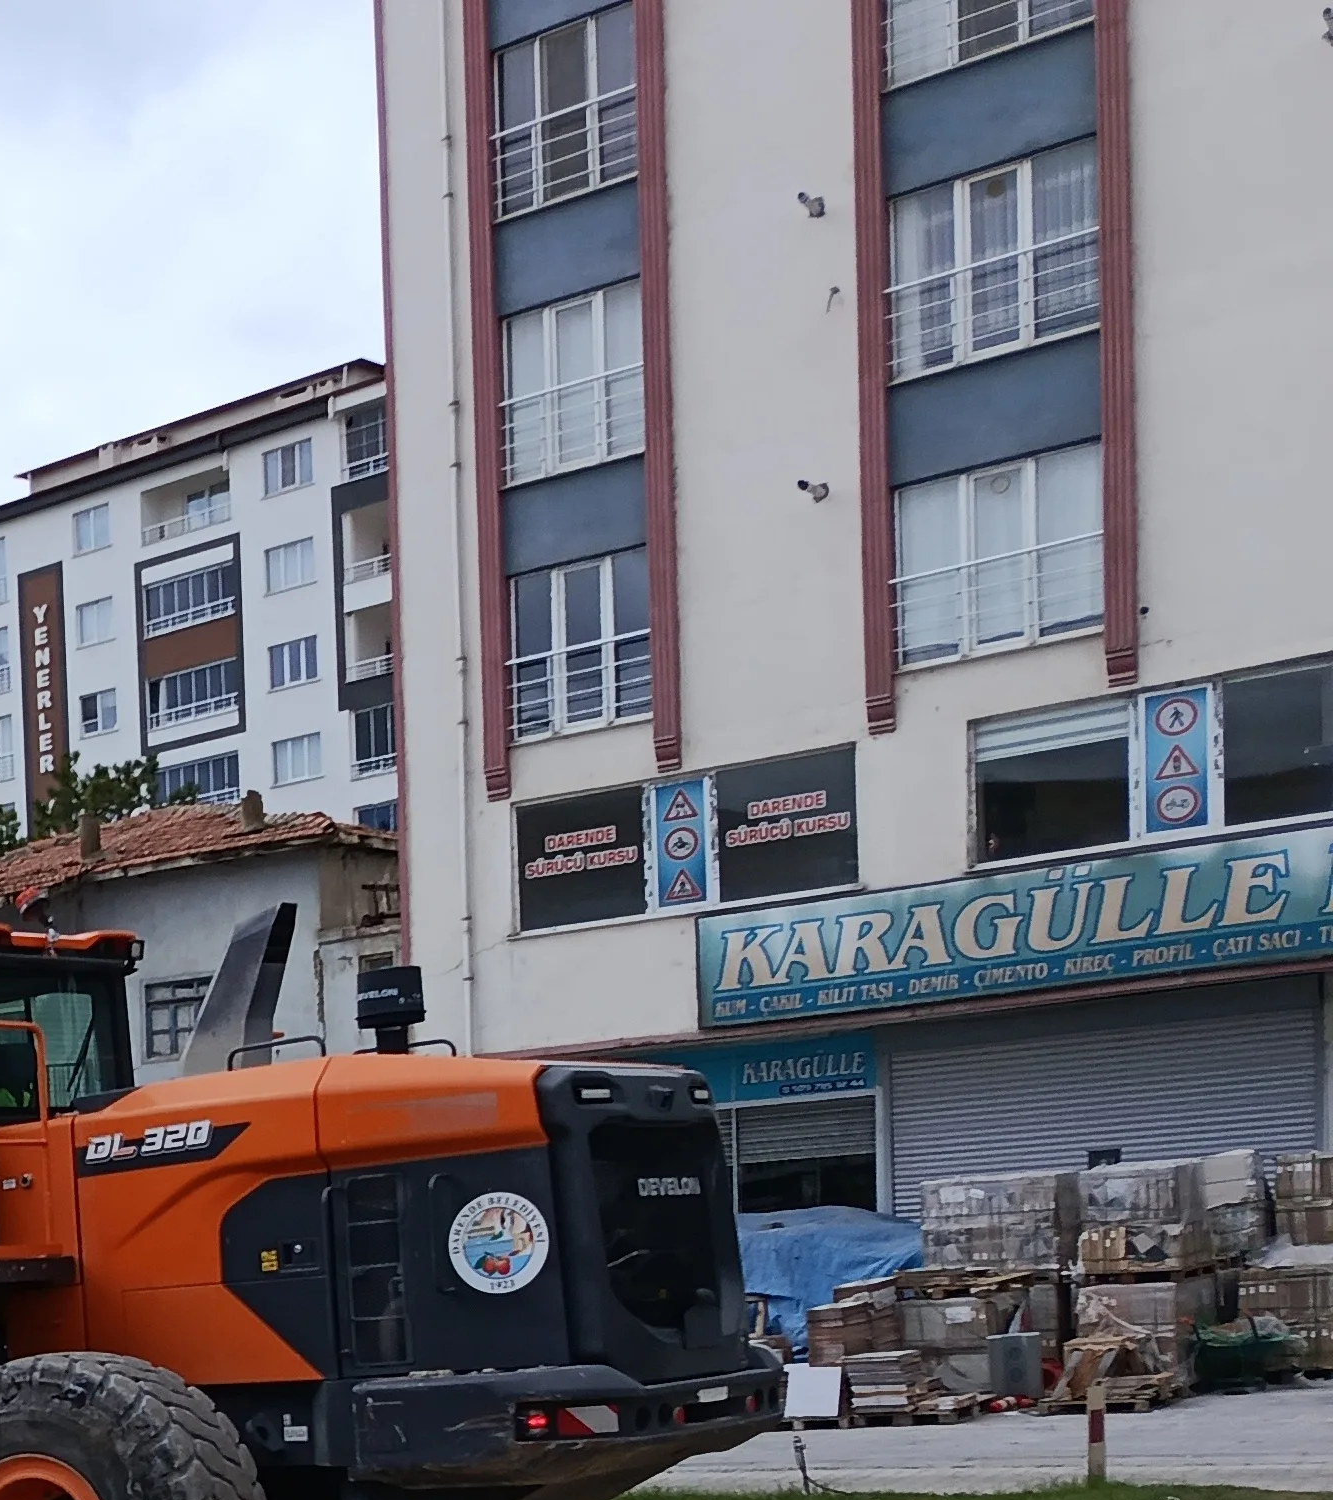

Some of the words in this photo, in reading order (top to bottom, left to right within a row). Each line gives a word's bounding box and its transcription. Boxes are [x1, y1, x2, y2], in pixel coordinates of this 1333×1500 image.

[33, 604, 54, 774] YENERLER
[747, 791, 826, 819] DARENDE
[544, 826, 616, 852] DARENDE
[726, 816, 791, 847] SÜRÜCÜ
[794, 811, 850, 834] KURSU
[525, 850, 583, 879] SÜRÜCÜ
[586, 846, 638, 868] KURSU
[714, 849, 1290, 993] KARAGÜLLE
[861, 981, 893, 1003] TAŞI
[908, 973, 959, 996] DEMİR
[973, 960, 1048, 993] ÇİMENTO
[1063, 953, 1116, 977] KİREÇ
[1132, 943, 1195, 968] PROFİL
[1212, 936, 1253, 961] ÇATI
[1258, 930, 1301, 950] SACI
[741, 1050, 866, 1085] KARAGÜLLE
[85, 1132, 137, 1165] DL
[140, 1119, 214, 1157] 320
